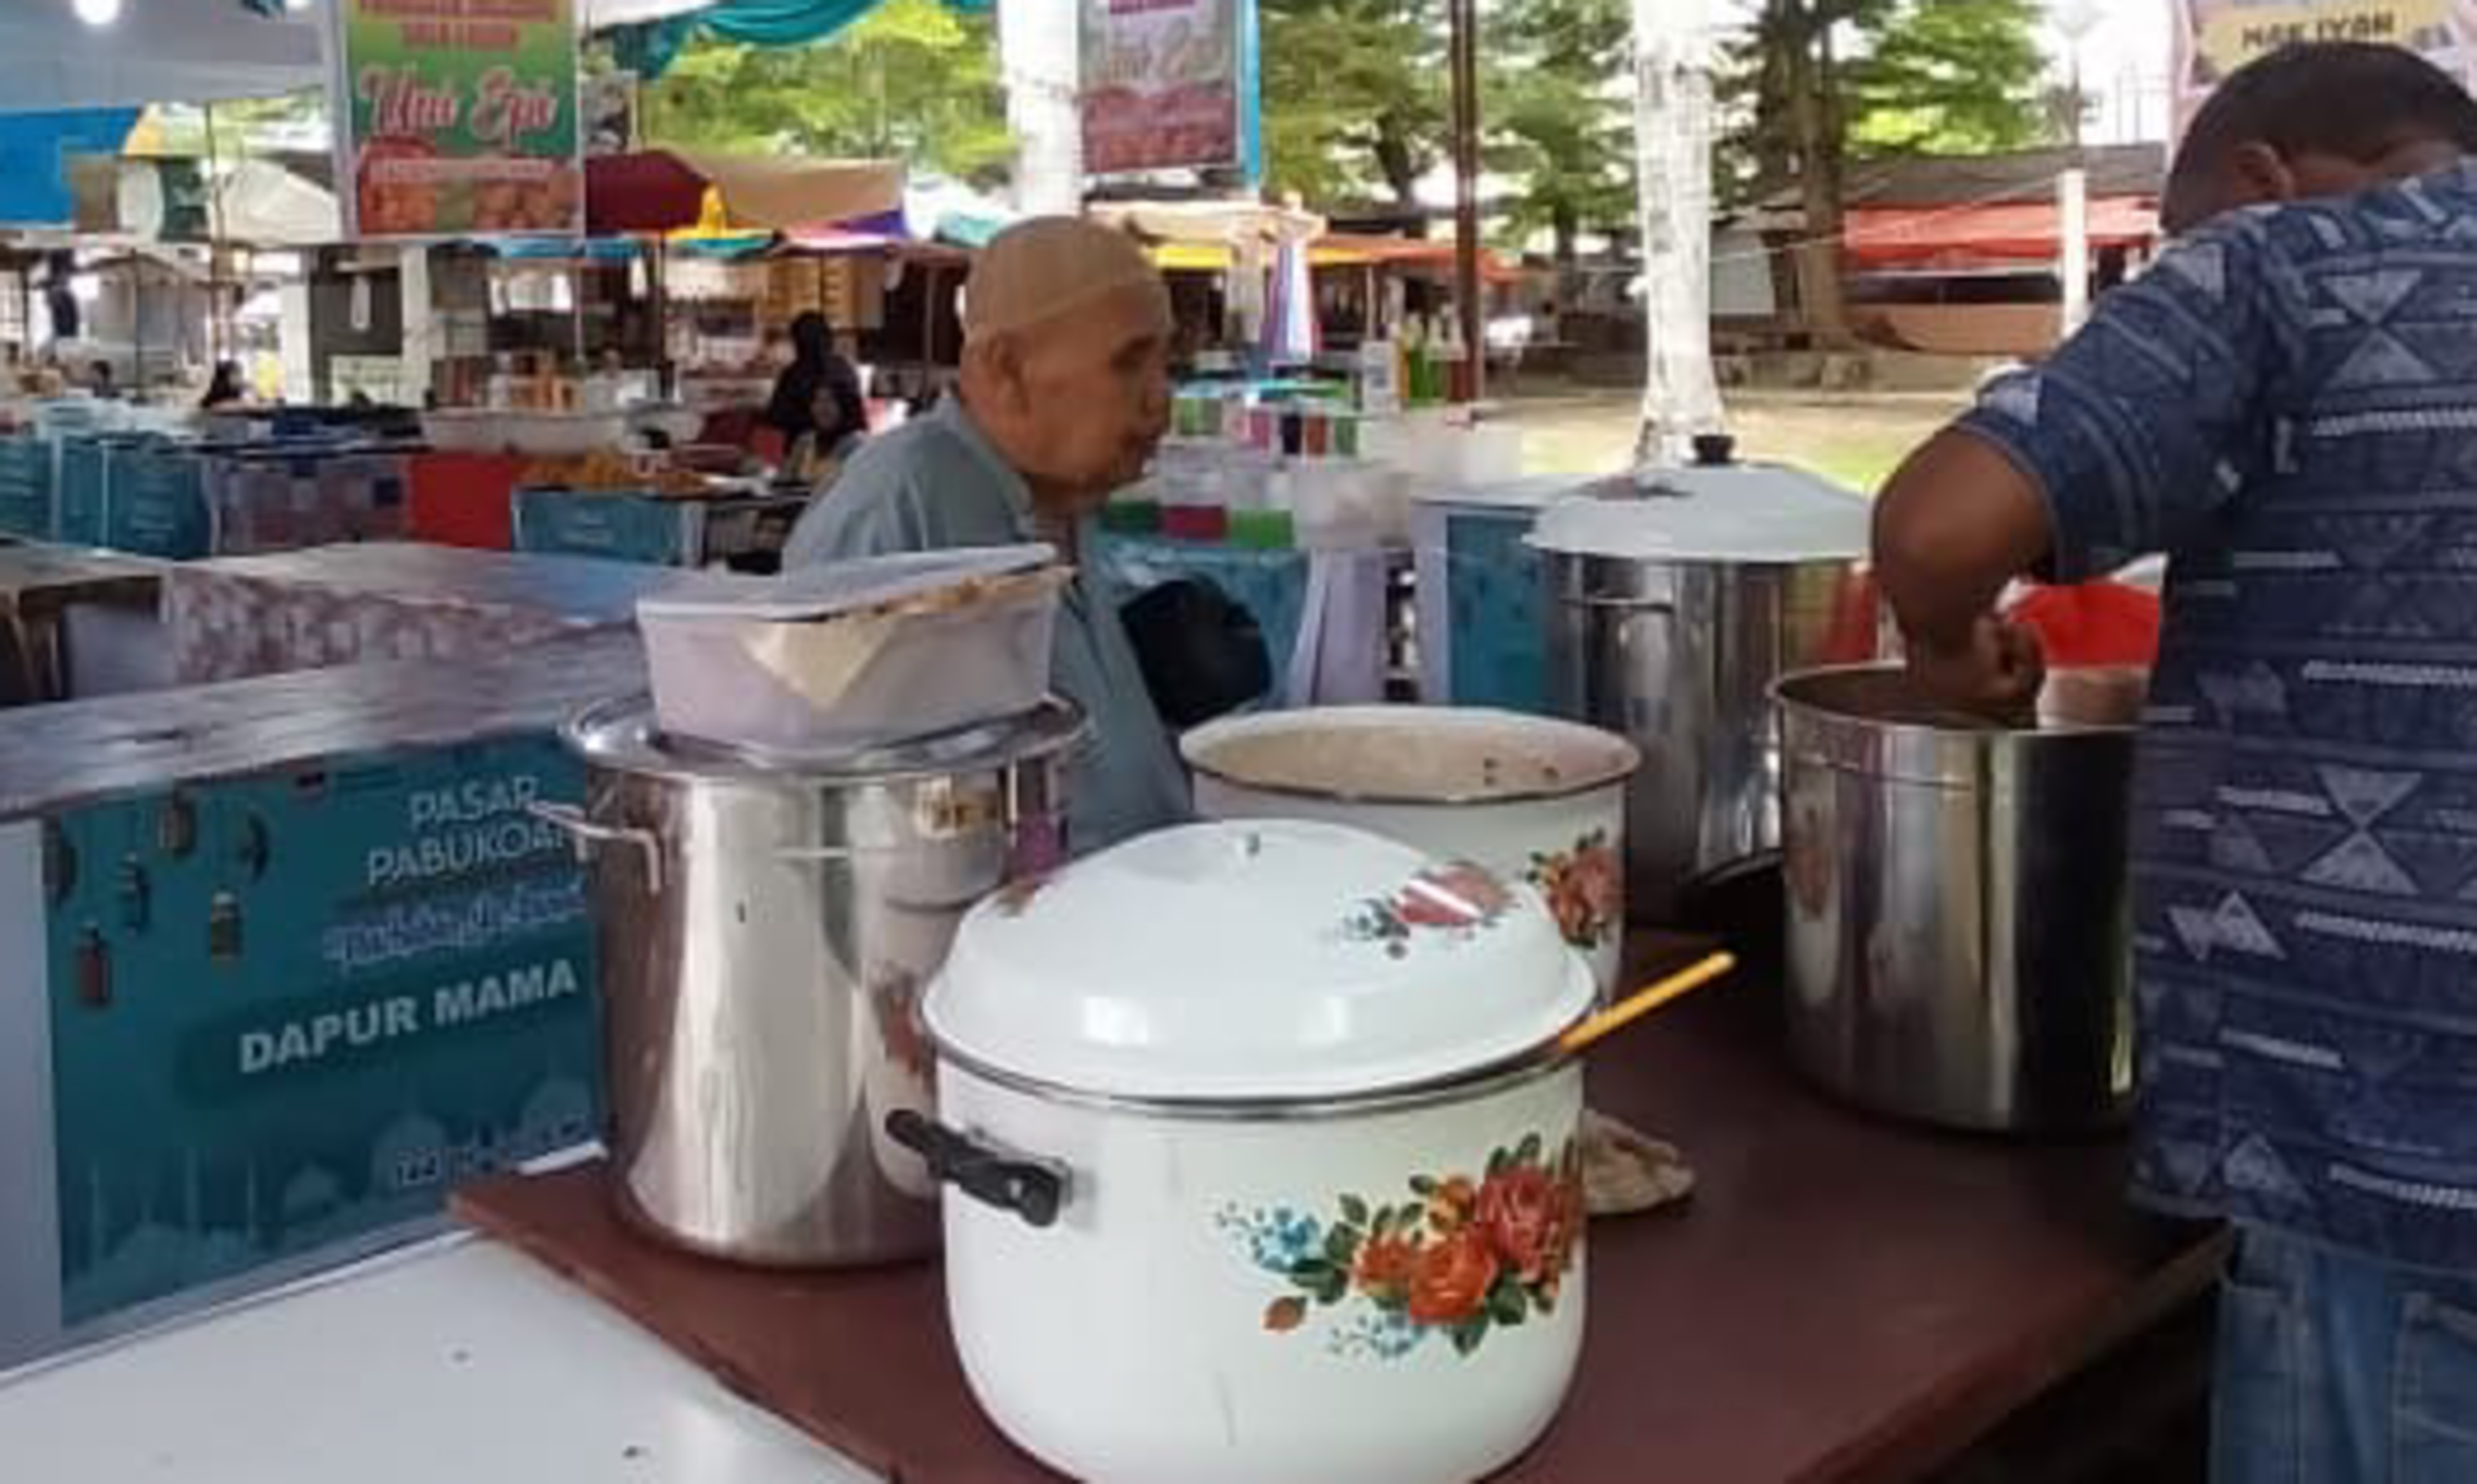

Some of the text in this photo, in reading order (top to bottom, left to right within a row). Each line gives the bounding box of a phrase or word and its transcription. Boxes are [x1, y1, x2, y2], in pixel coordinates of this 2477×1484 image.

[410, 776, 539, 830] PASAR
[240, 958, 577, 1074] DAPUR MAMA
